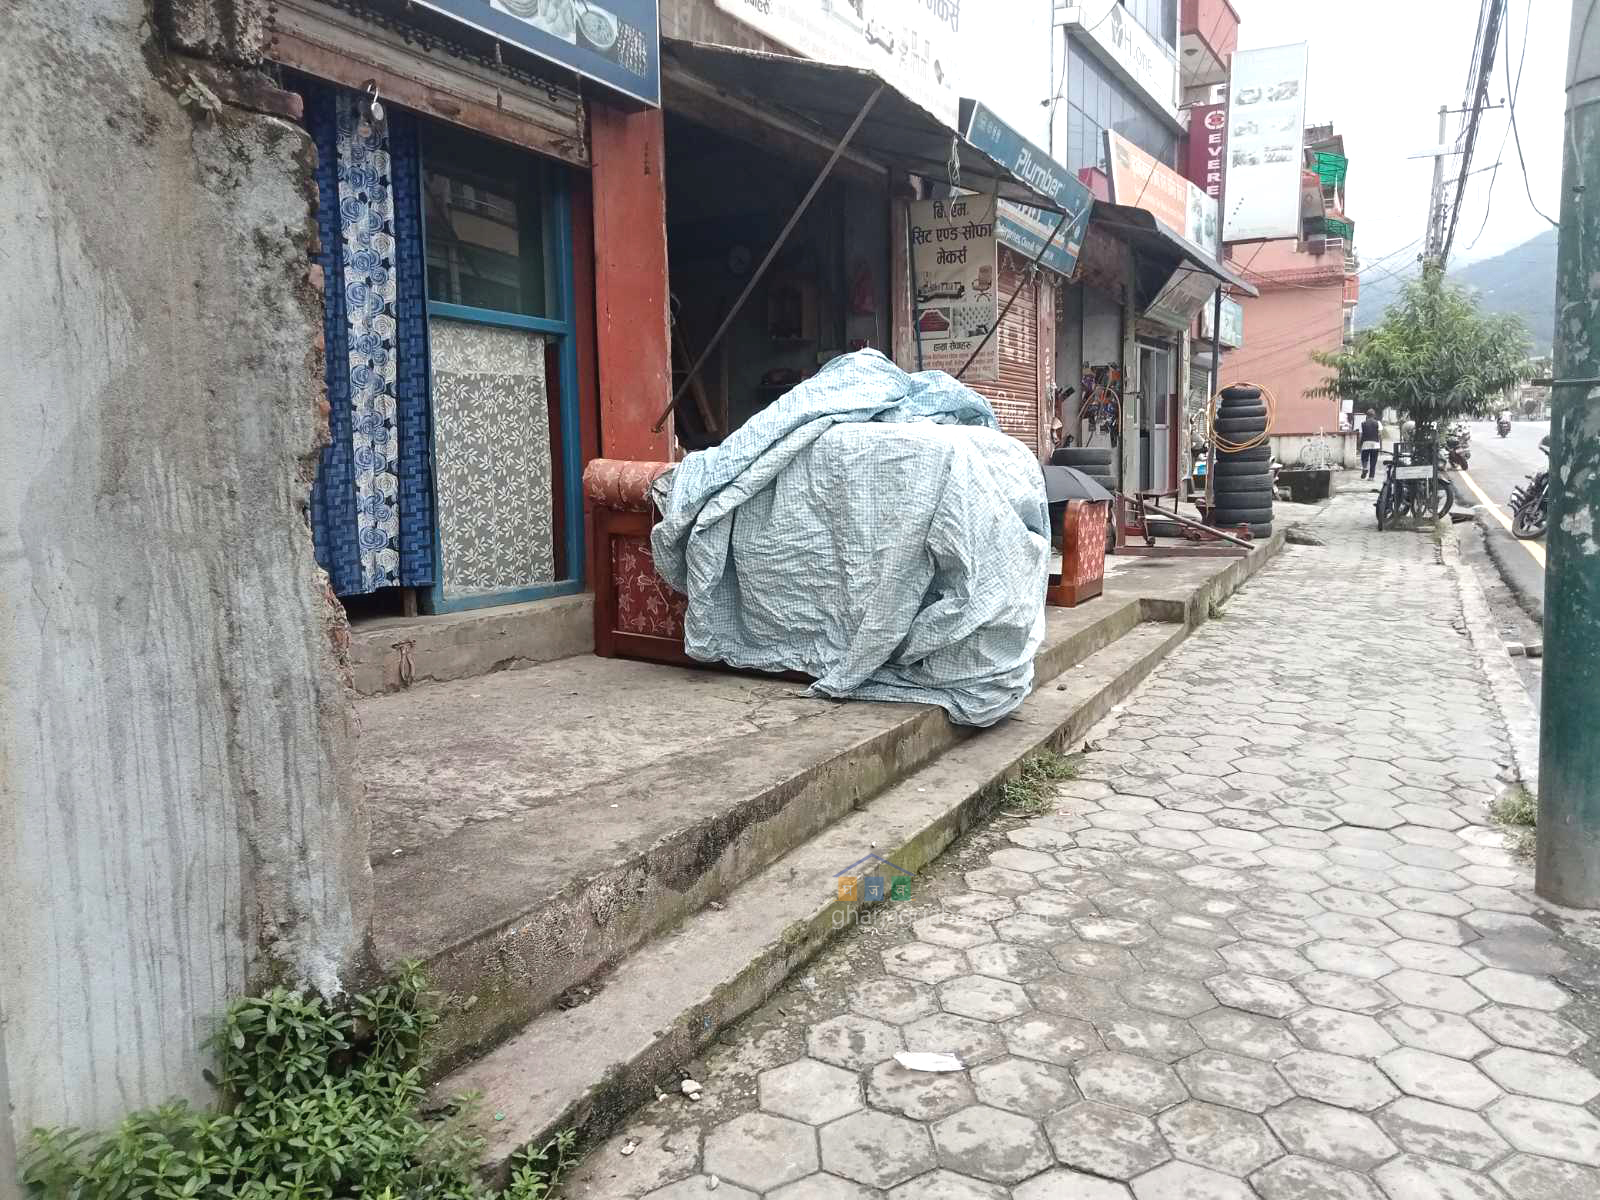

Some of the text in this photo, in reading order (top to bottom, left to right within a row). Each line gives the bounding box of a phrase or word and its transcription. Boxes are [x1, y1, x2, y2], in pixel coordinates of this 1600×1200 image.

[1014, 147, 1063, 197] Plumber
[912, 226, 933, 244] सिट
[936, 226, 960, 241] एण्ड
[961, 221, 993, 240] सोफा
[936, 245, 967, 264] मेकर्स
